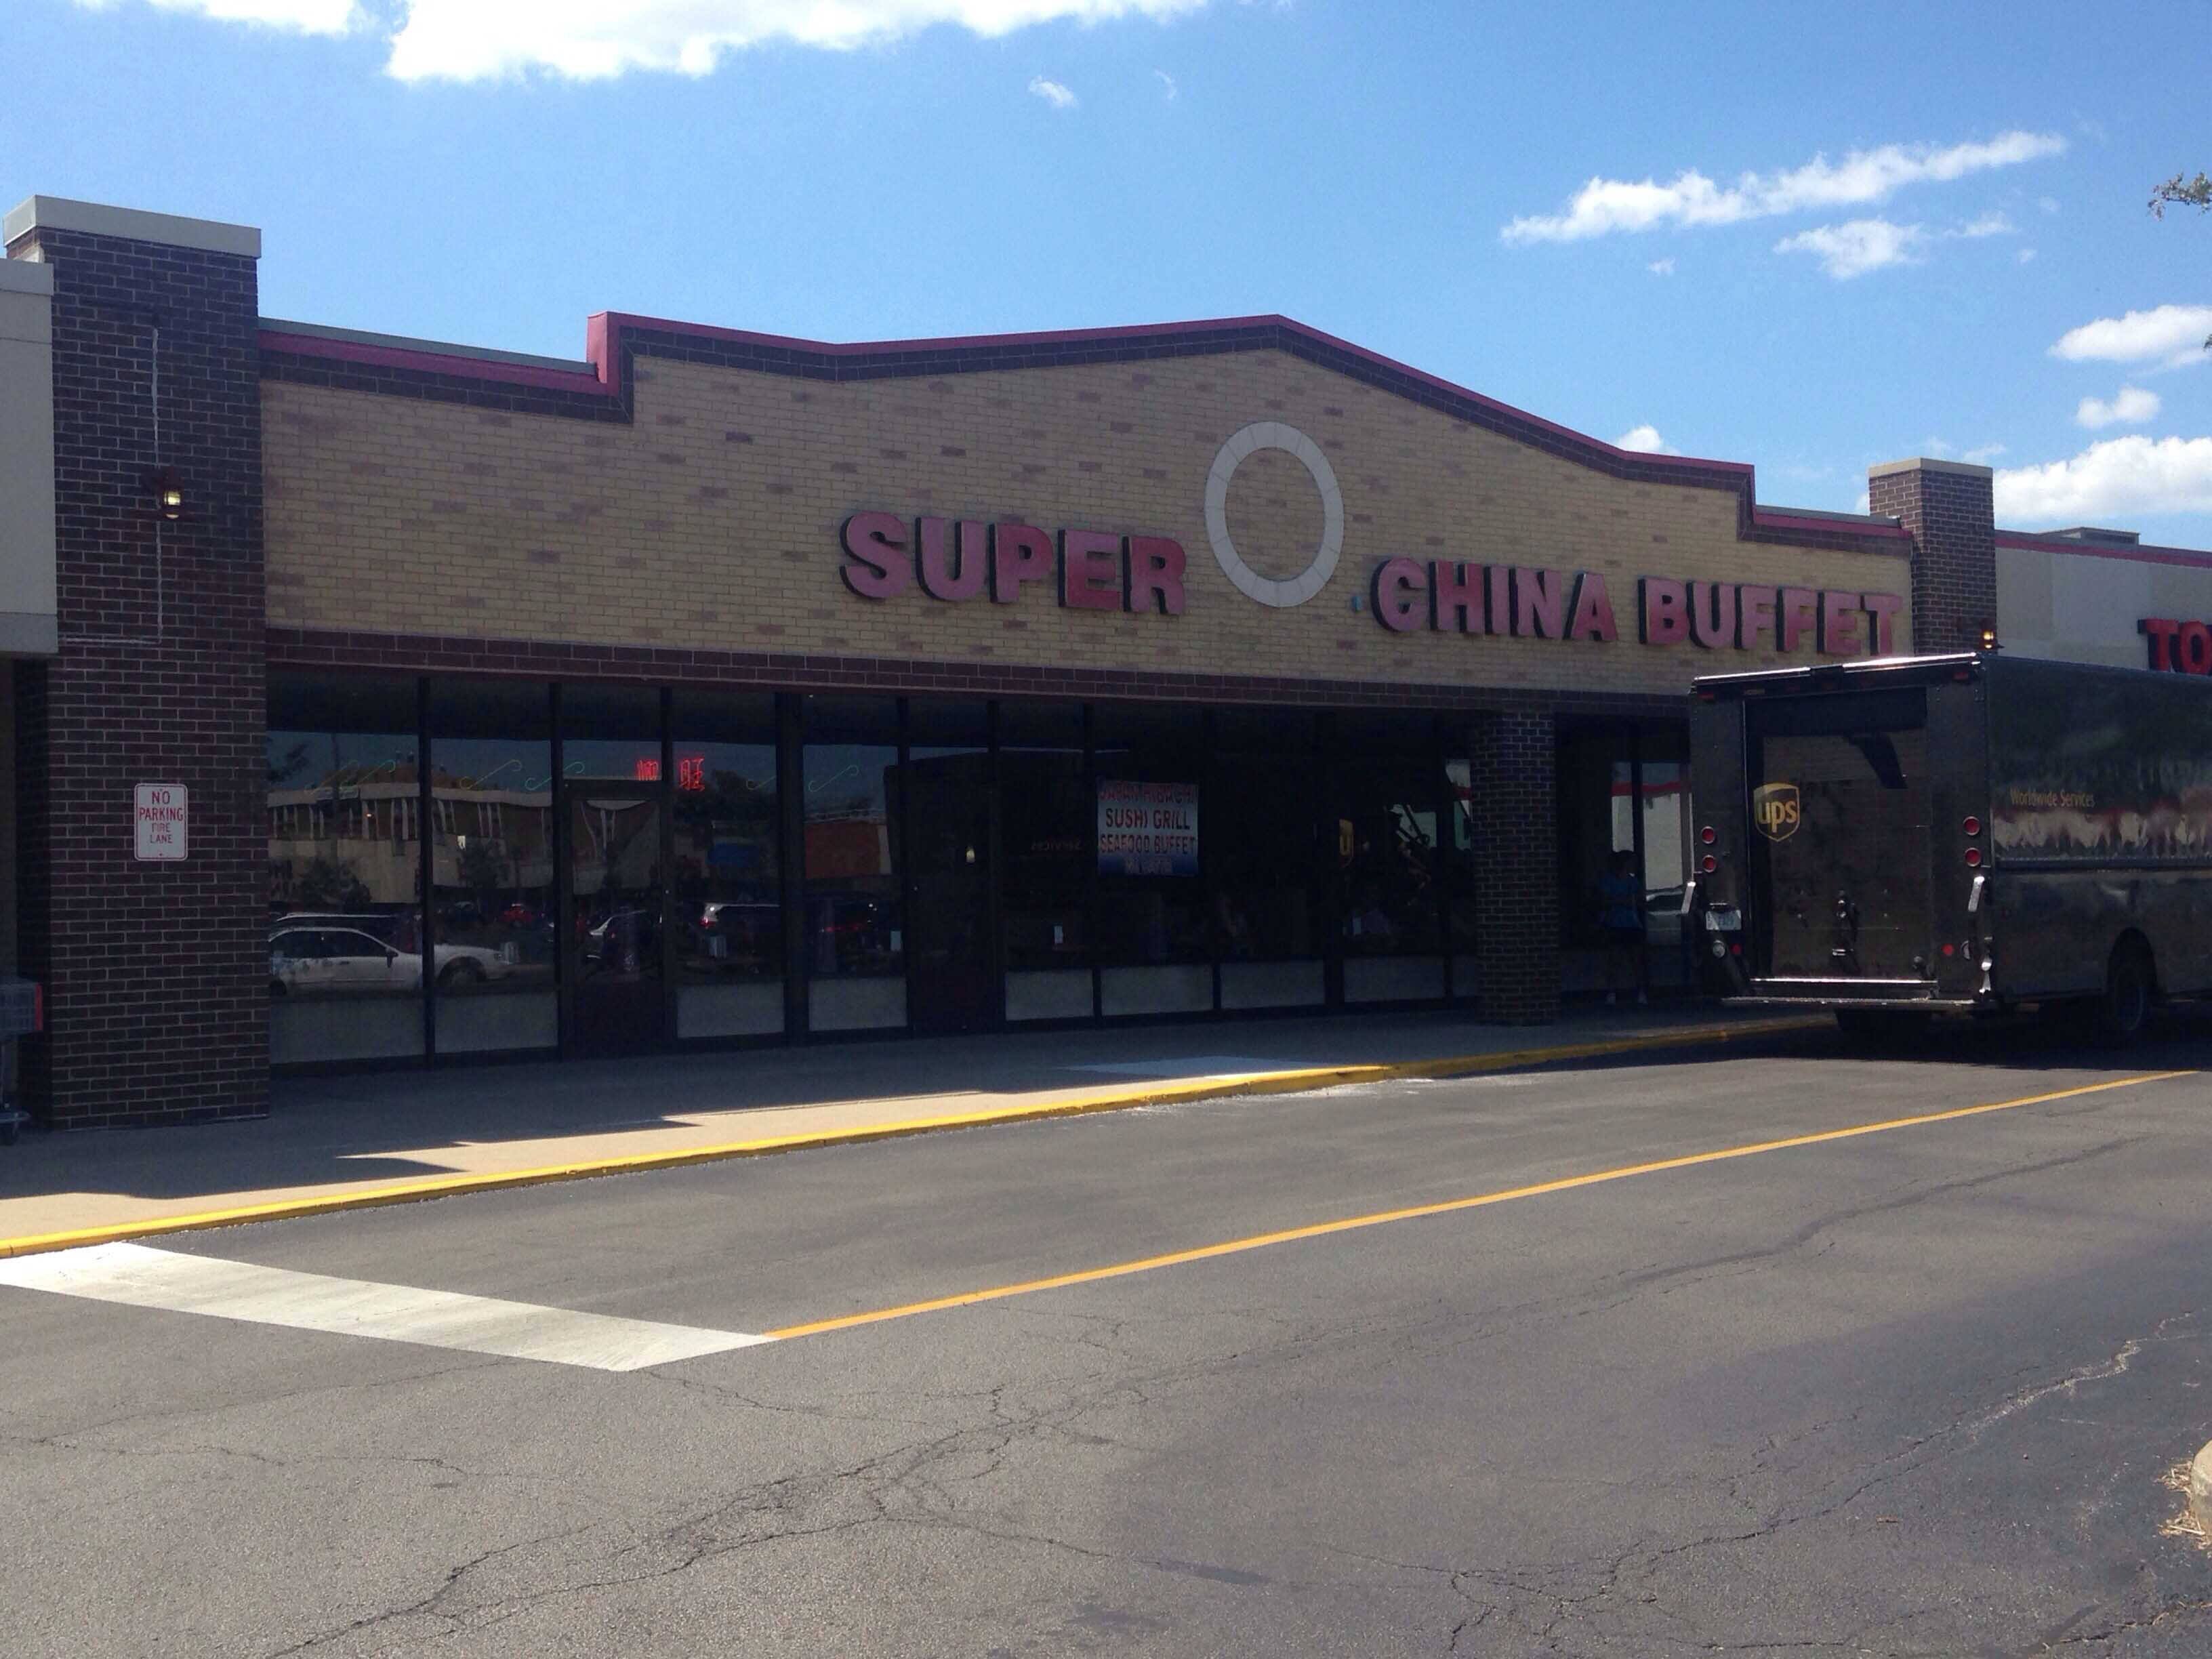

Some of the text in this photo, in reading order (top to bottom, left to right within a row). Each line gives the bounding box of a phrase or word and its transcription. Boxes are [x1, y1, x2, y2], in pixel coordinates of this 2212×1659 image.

[839, 510, 1187, 615] SUPER
[1370, 556, 1902, 656] CHINA BUFFET
[2137, 616, 2212, 676] TO
[151, 791, 171, 805] NO
[138, 807, 184, 821] PARKING
[1105, 808, 1191, 830] SUSHI GRILL
[151, 823, 171, 833] FIRE
[150, 834, 172, 844] LANE
[1100, 834, 1150, 854] SEAFOOD
[1154, 834, 1195, 855] BUFFET
